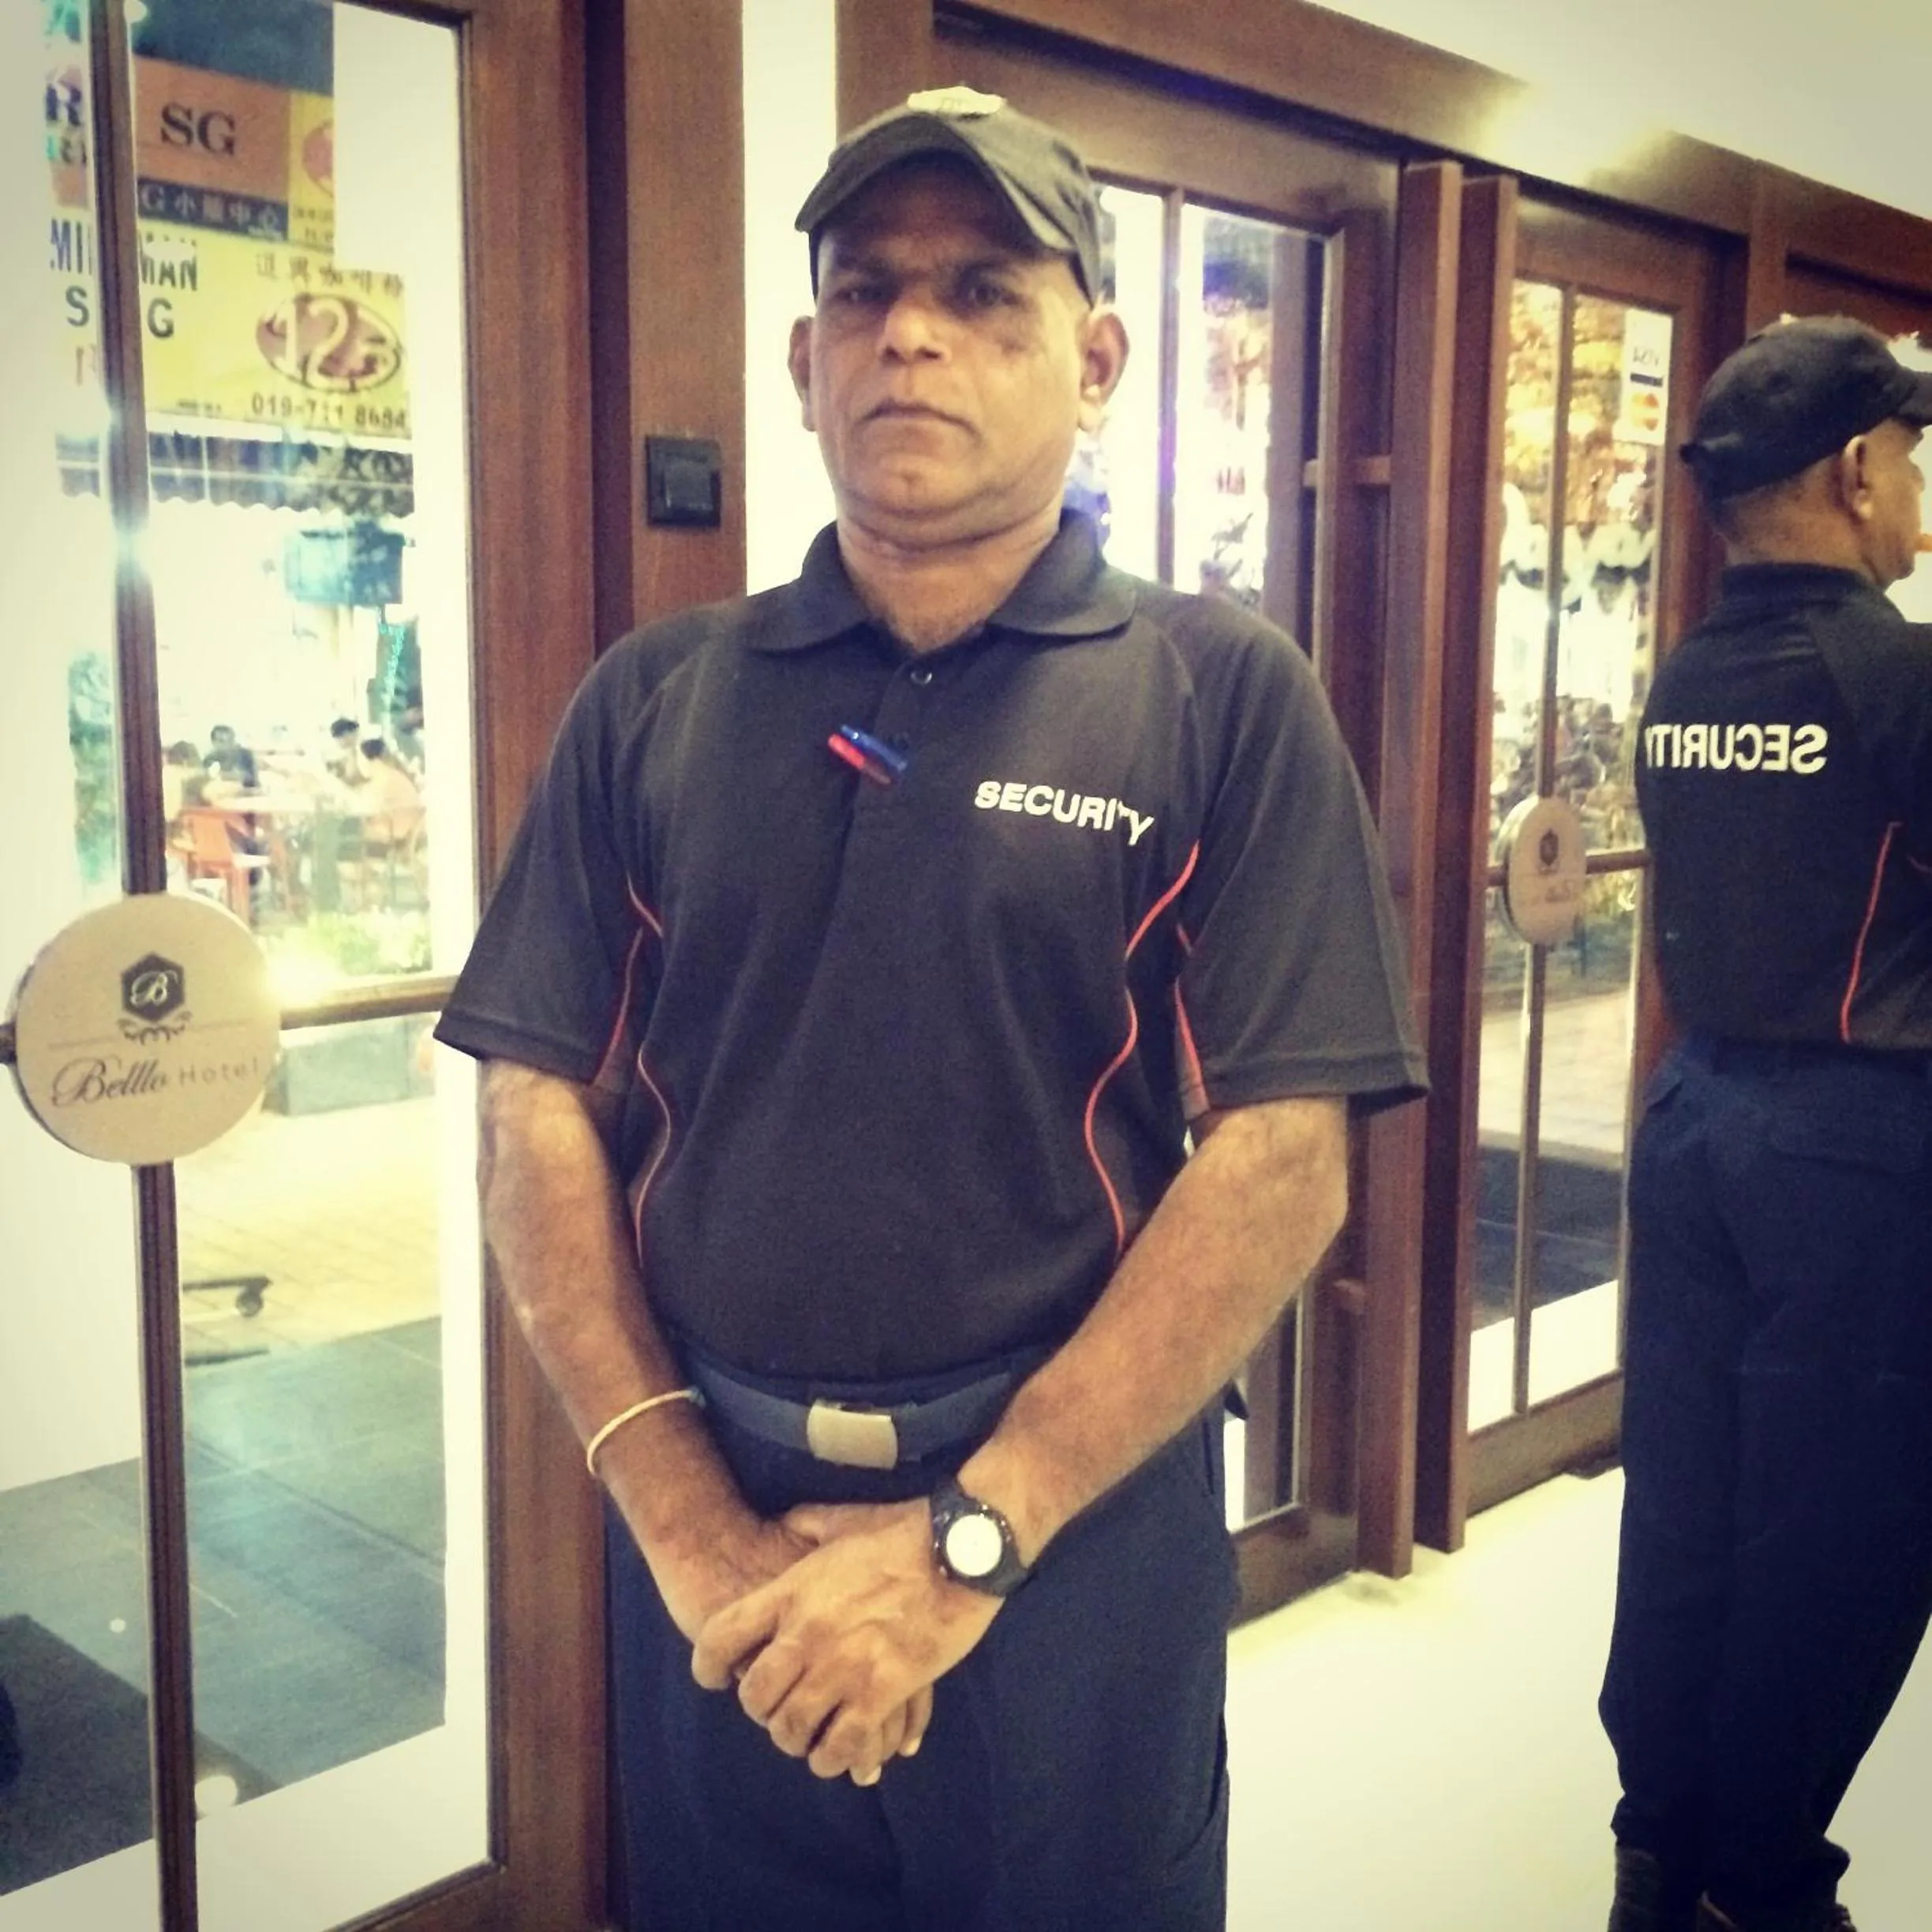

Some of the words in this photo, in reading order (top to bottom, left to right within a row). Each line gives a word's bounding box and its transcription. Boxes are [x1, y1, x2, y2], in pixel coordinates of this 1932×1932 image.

[160, 102, 236, 155] SG
[974, 780, 1155, 847] SECURIY
[178, 1056, 259, 1088] Hotel
